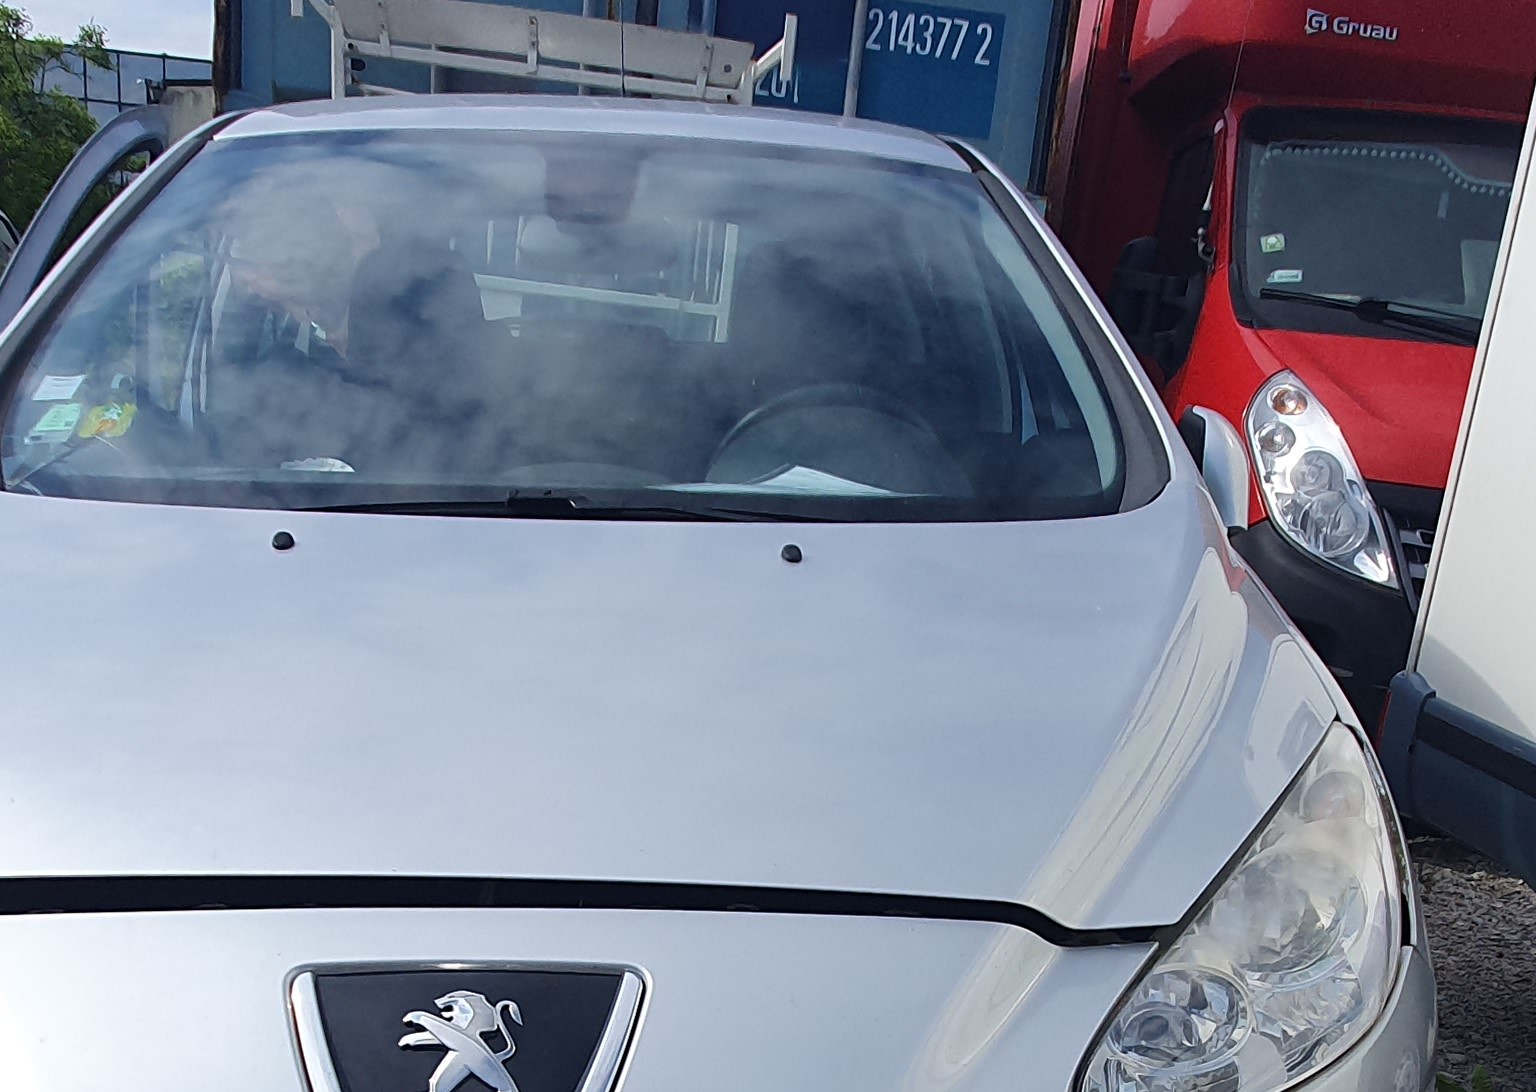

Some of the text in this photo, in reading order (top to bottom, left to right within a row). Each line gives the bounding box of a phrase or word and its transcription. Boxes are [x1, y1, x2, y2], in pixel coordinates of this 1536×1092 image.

[865, 8, 993, 66] 214377 2
[1333, 16, 1398, 40] Gruau
